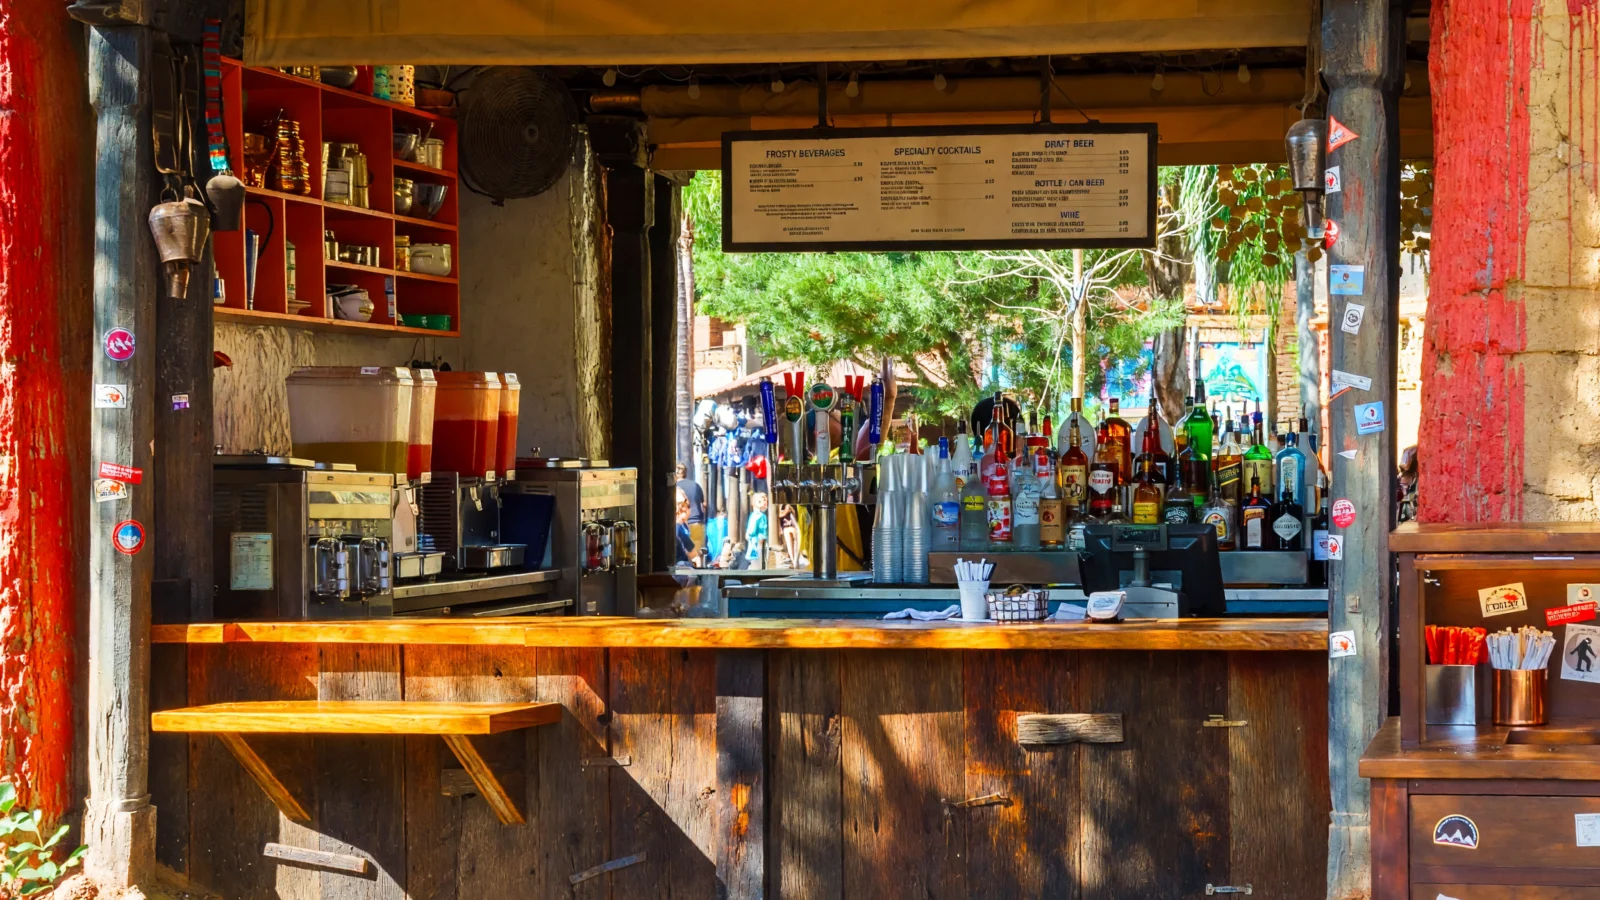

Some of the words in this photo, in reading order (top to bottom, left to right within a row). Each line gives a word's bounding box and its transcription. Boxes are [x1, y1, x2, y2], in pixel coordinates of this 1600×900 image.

[1044, 139, 1070, 148] DRAFT
[1073, 139, 1095, 148] BEER
[765, 150, 797, 158] FROSTY
[799, 149, 846, 158] BEVERAGES
[894, 147, 936, 156] SPECIALTY
[937, 146, 982, 155] COCKTAILS
[1068, 179, 1085, 187] CAN
